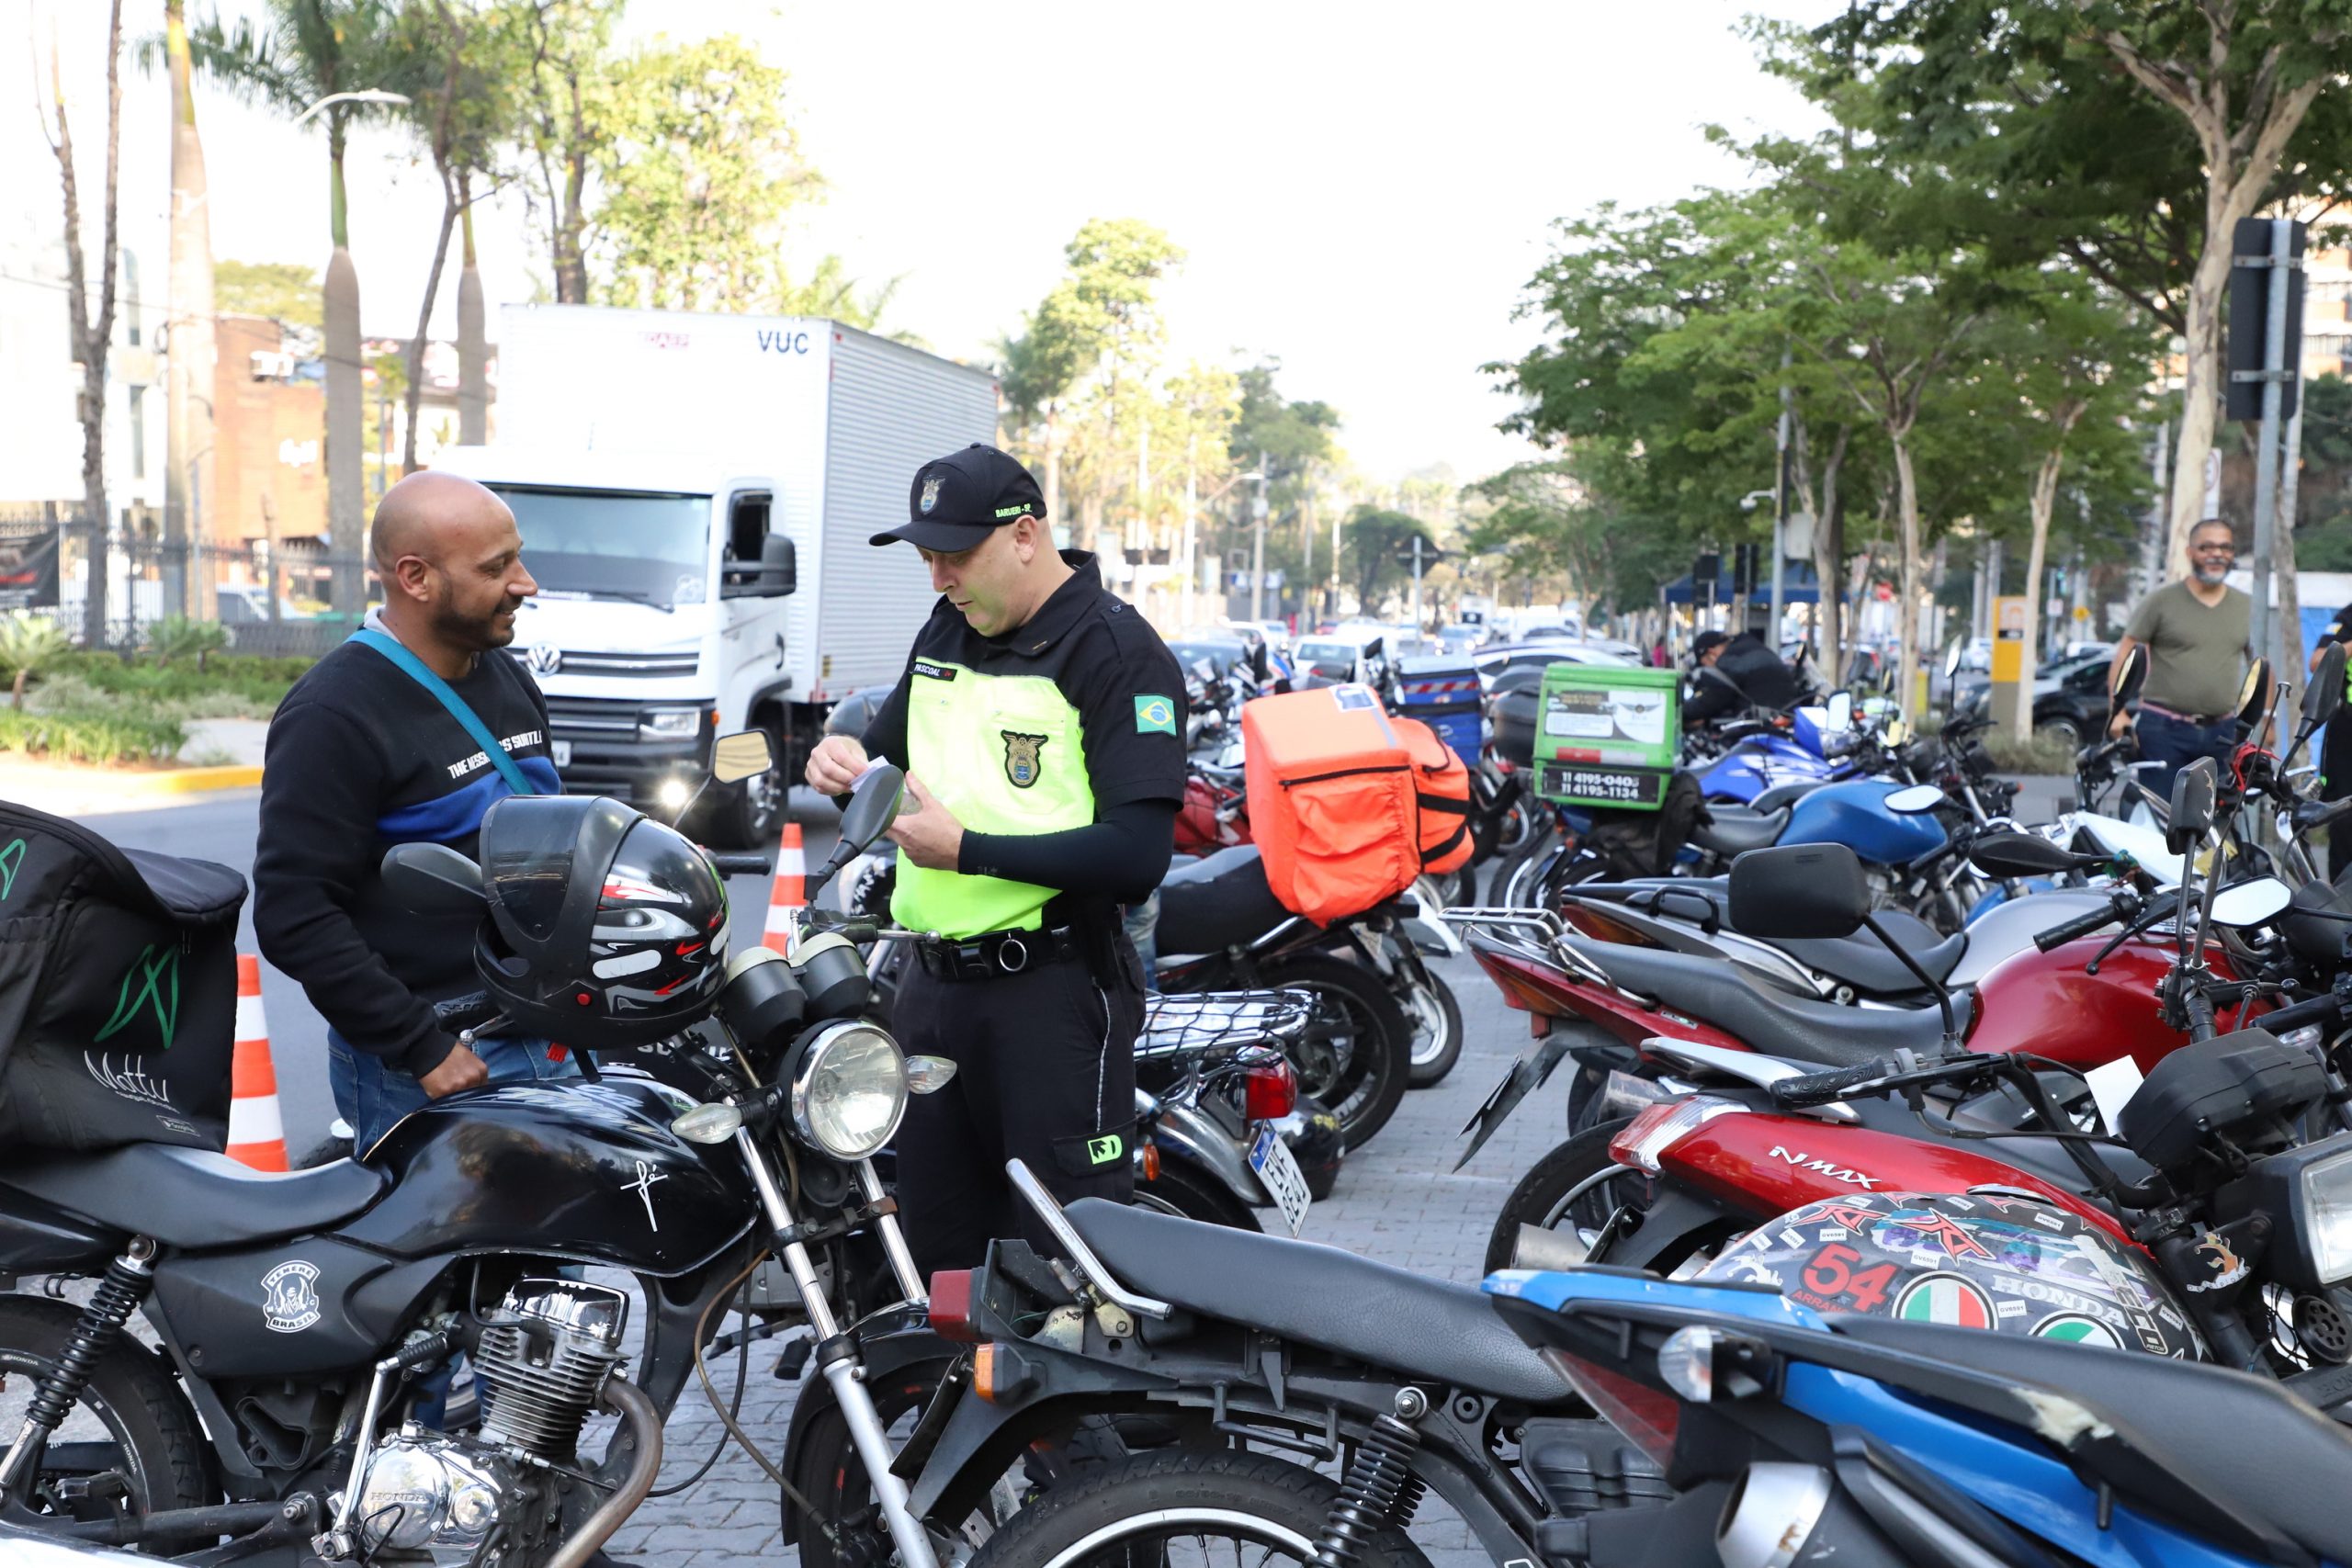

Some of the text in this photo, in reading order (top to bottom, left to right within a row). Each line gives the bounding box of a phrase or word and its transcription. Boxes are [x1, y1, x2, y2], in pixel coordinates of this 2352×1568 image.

[757, 330, 809, 355] VUC
[995, 505, 1022, 518] BARUERI
[1023, 503, 1032, 513] SP
[913, 663, 941, 677] PASCOAL
[447, 758, 470, 779] THE
[1573, 784, 1639, 799] 4195-1134
[1769, 1145, 1882, 1190] NMAX
[1803, 1243, 1900, 1313] 54
[1991, 1274, 2130, 1330] HONDA
[272, 1313, 316, 1328] BRASIL
[11, 1355, 39, 1367] HONDA
[122, 1443, 139, 1475] HONDA
[370, 1492, 427, 1502] HONDA
